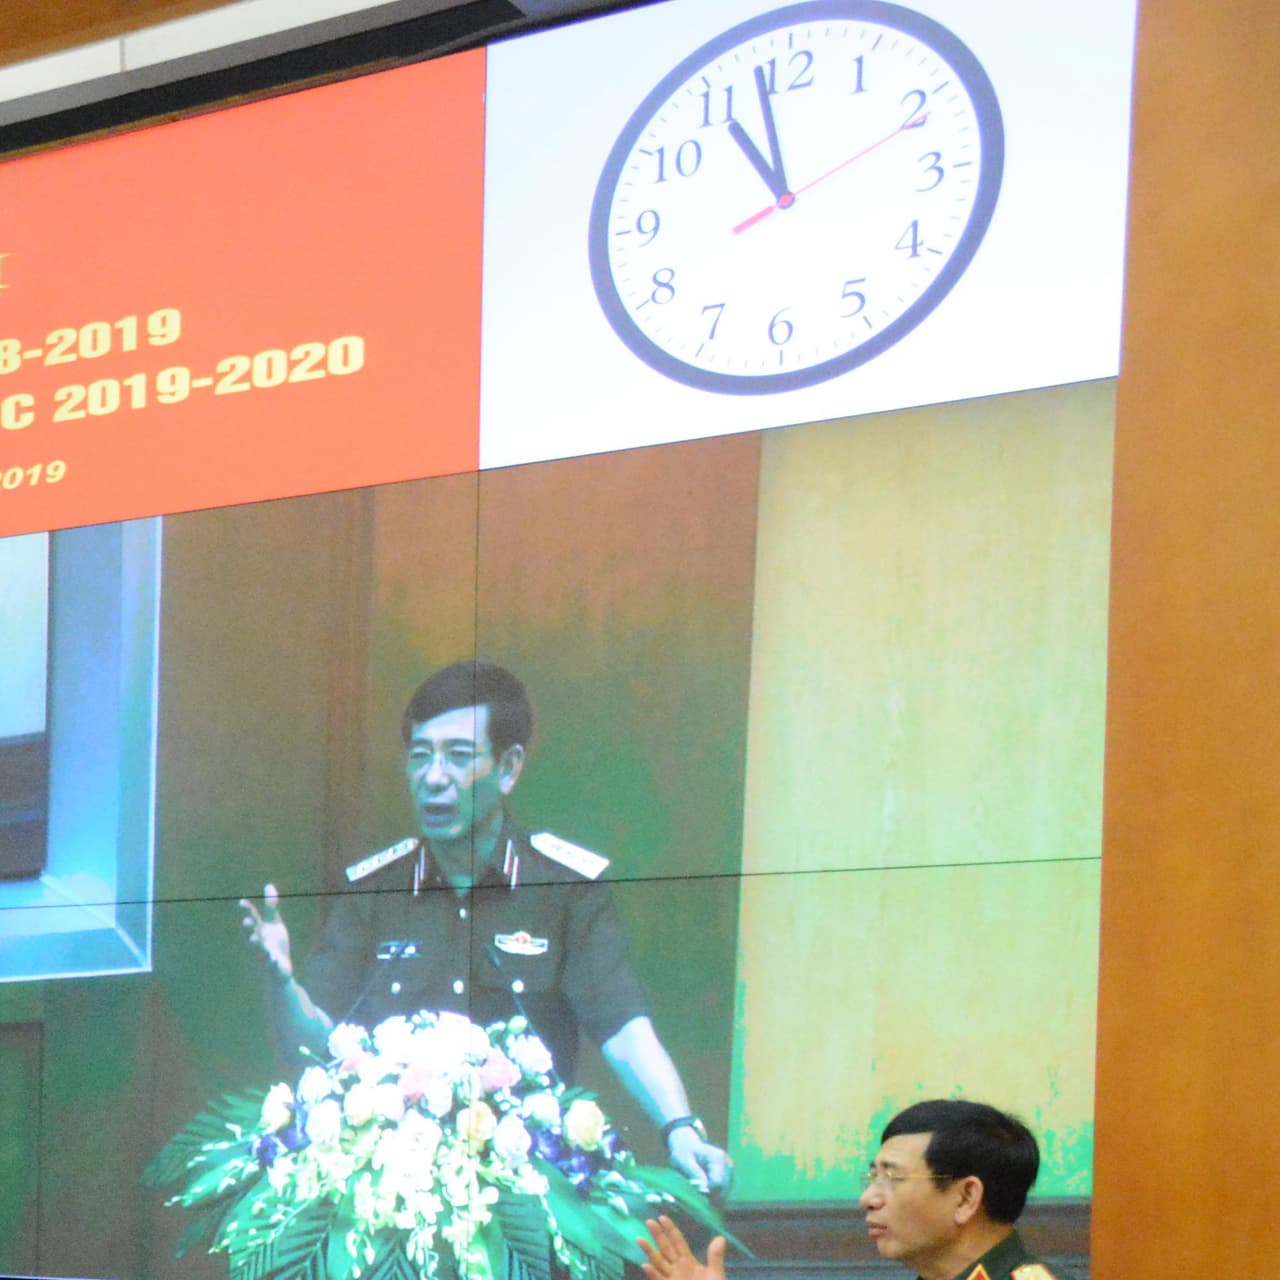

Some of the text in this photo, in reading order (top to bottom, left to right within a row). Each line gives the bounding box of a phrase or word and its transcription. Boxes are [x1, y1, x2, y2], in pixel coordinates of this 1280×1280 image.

[765, 50, 815, 96] 12
[851, 55, 868, 94] 1
[698, 84, 737, 128] 11
[900, 89, 928, 129] 2
[654, 139, 702, 184] 10
[914, 151, 945, 193] 3
[636, 209, 661, 247] 9
[894, 219, 924, 259] 4
[650, 267, 676, 305] 8
[840, 278, 867, 318] 5
[701, 303, 726, 340] 7
[767, 307, 793, 346] 6
[51, 335, 365, 424] 2019-2020
